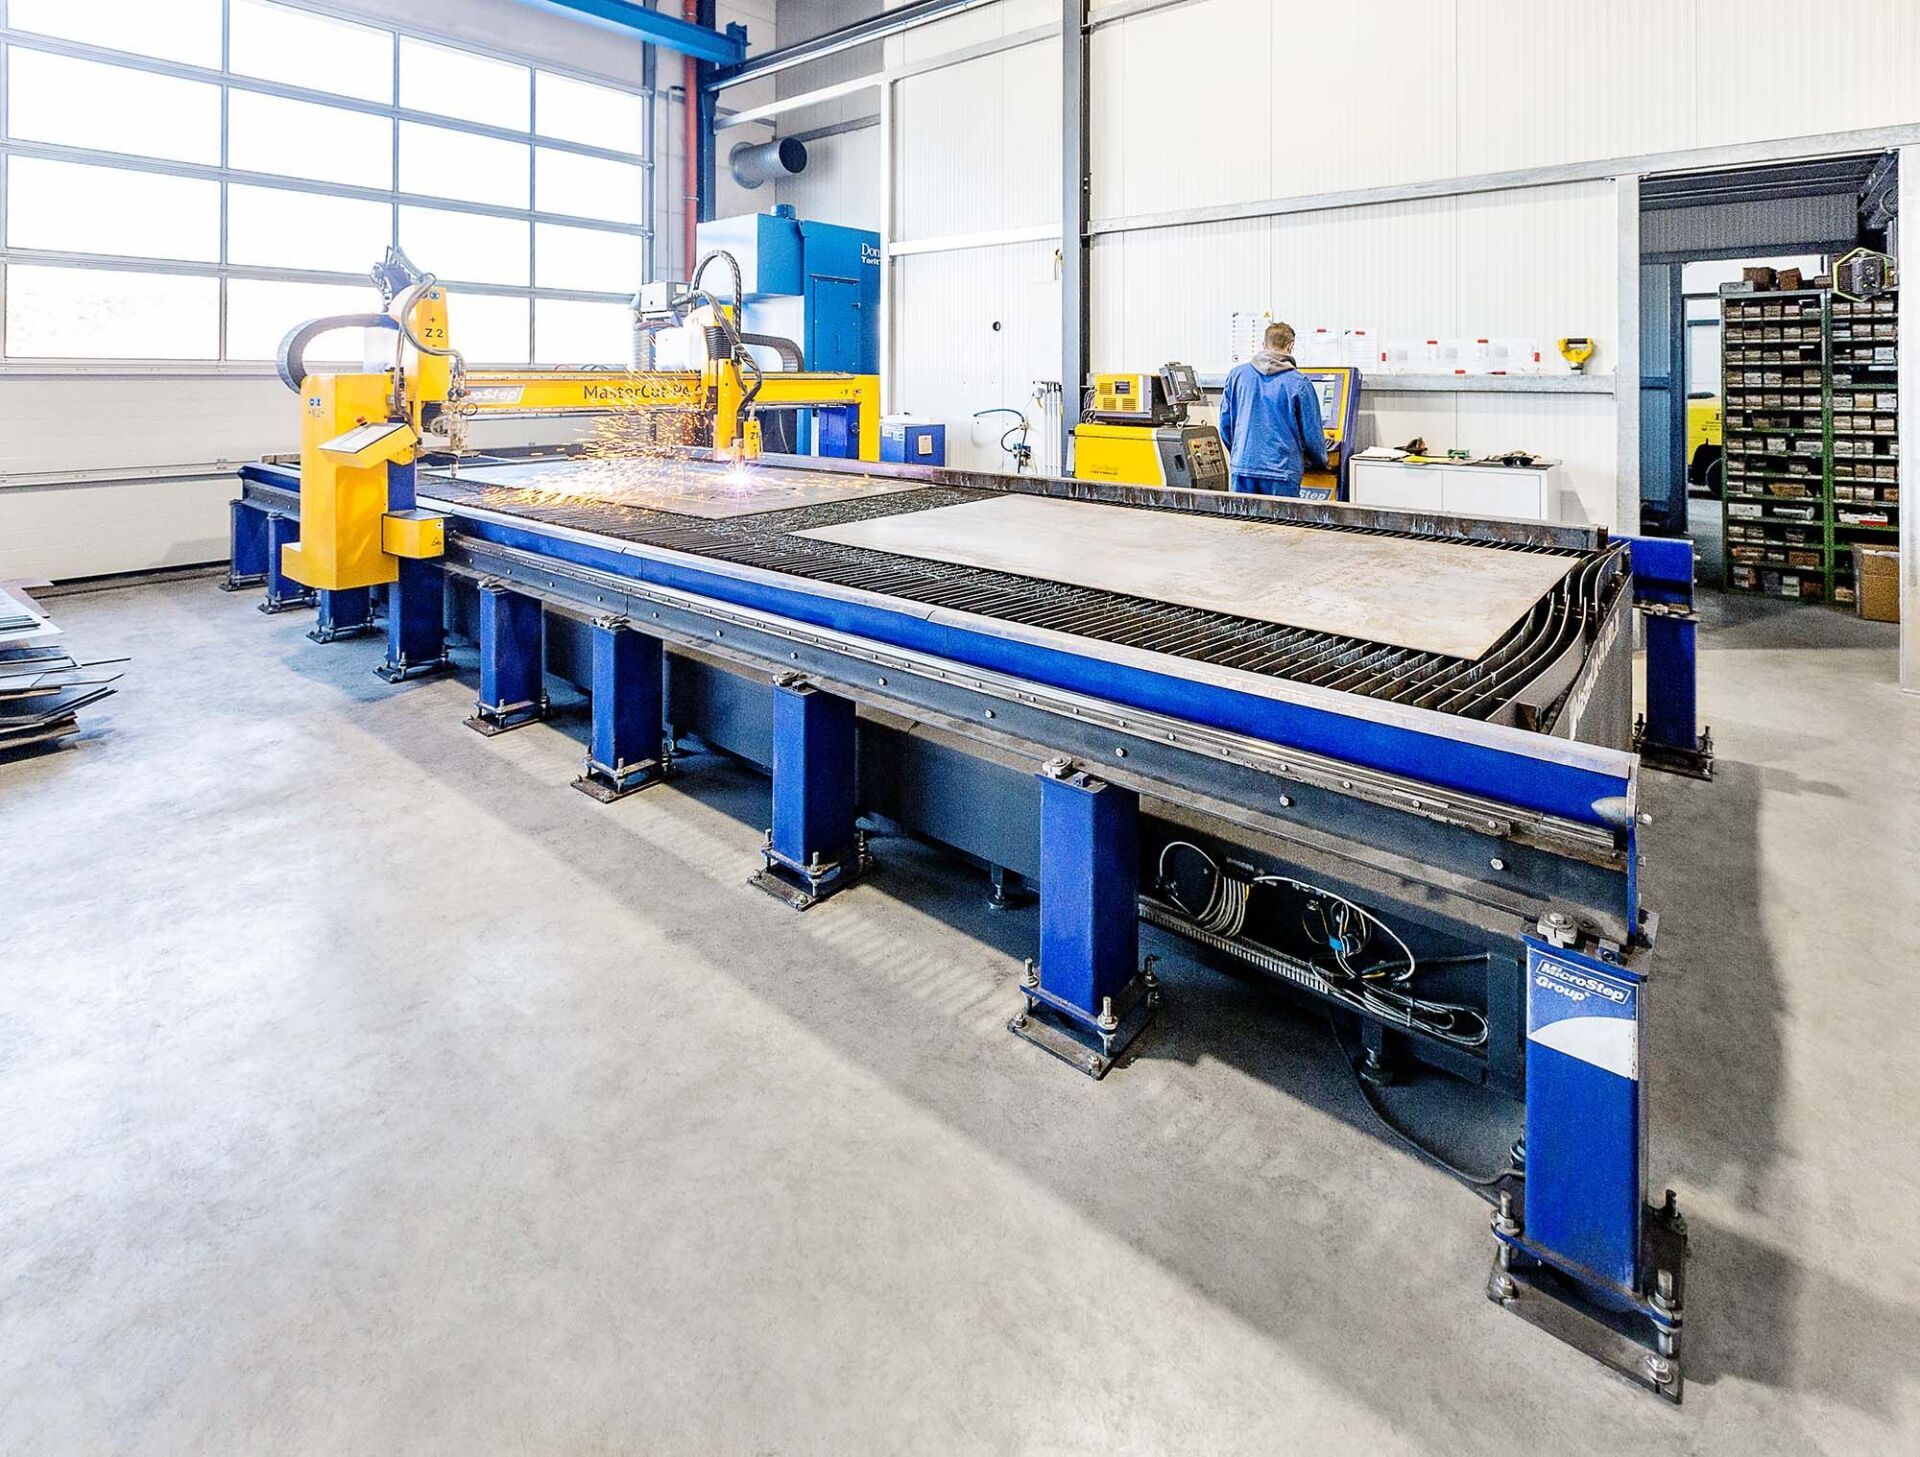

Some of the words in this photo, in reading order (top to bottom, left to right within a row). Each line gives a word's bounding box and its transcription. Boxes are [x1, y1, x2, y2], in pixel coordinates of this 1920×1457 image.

[861, 242, 880, 257] Don
[1299, 489, 1327, 501] Step
[1535, 975, 1586, 1002] Group
[1540, 962, 1625, 1001] MicroStep
